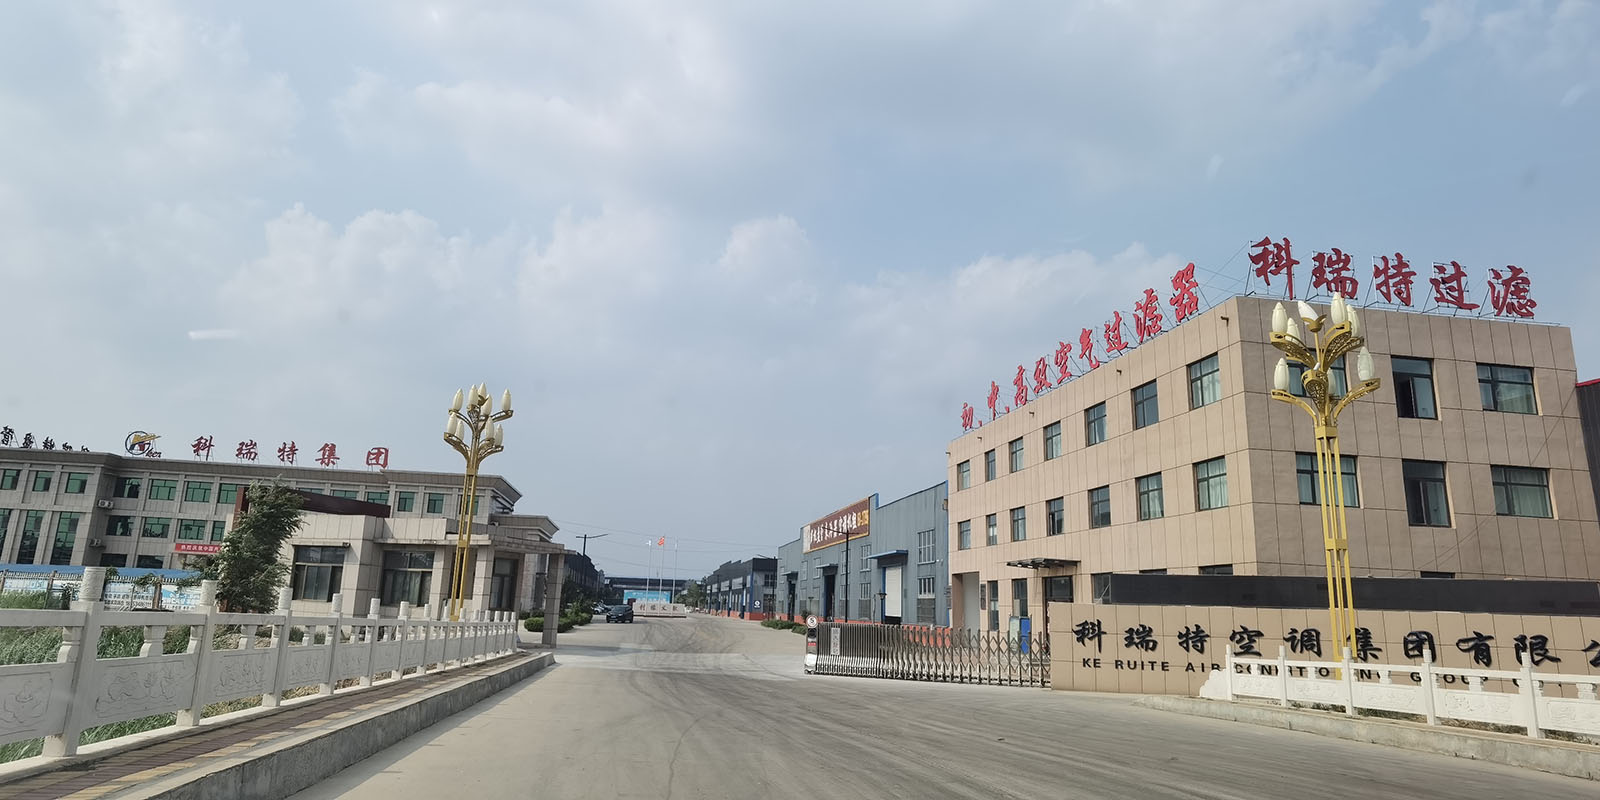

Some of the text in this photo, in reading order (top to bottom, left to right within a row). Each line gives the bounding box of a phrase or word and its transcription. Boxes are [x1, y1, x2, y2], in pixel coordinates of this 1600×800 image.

[1248, 236, 1537, 319] 科瑞特过滤
[191, 435, 390, 469] 科瑞特集团
[1082, 657, 1102, 669] KE
[1115, 659, 1170, 672] RUITE
[1184, 661, 1221, 673] AIR
